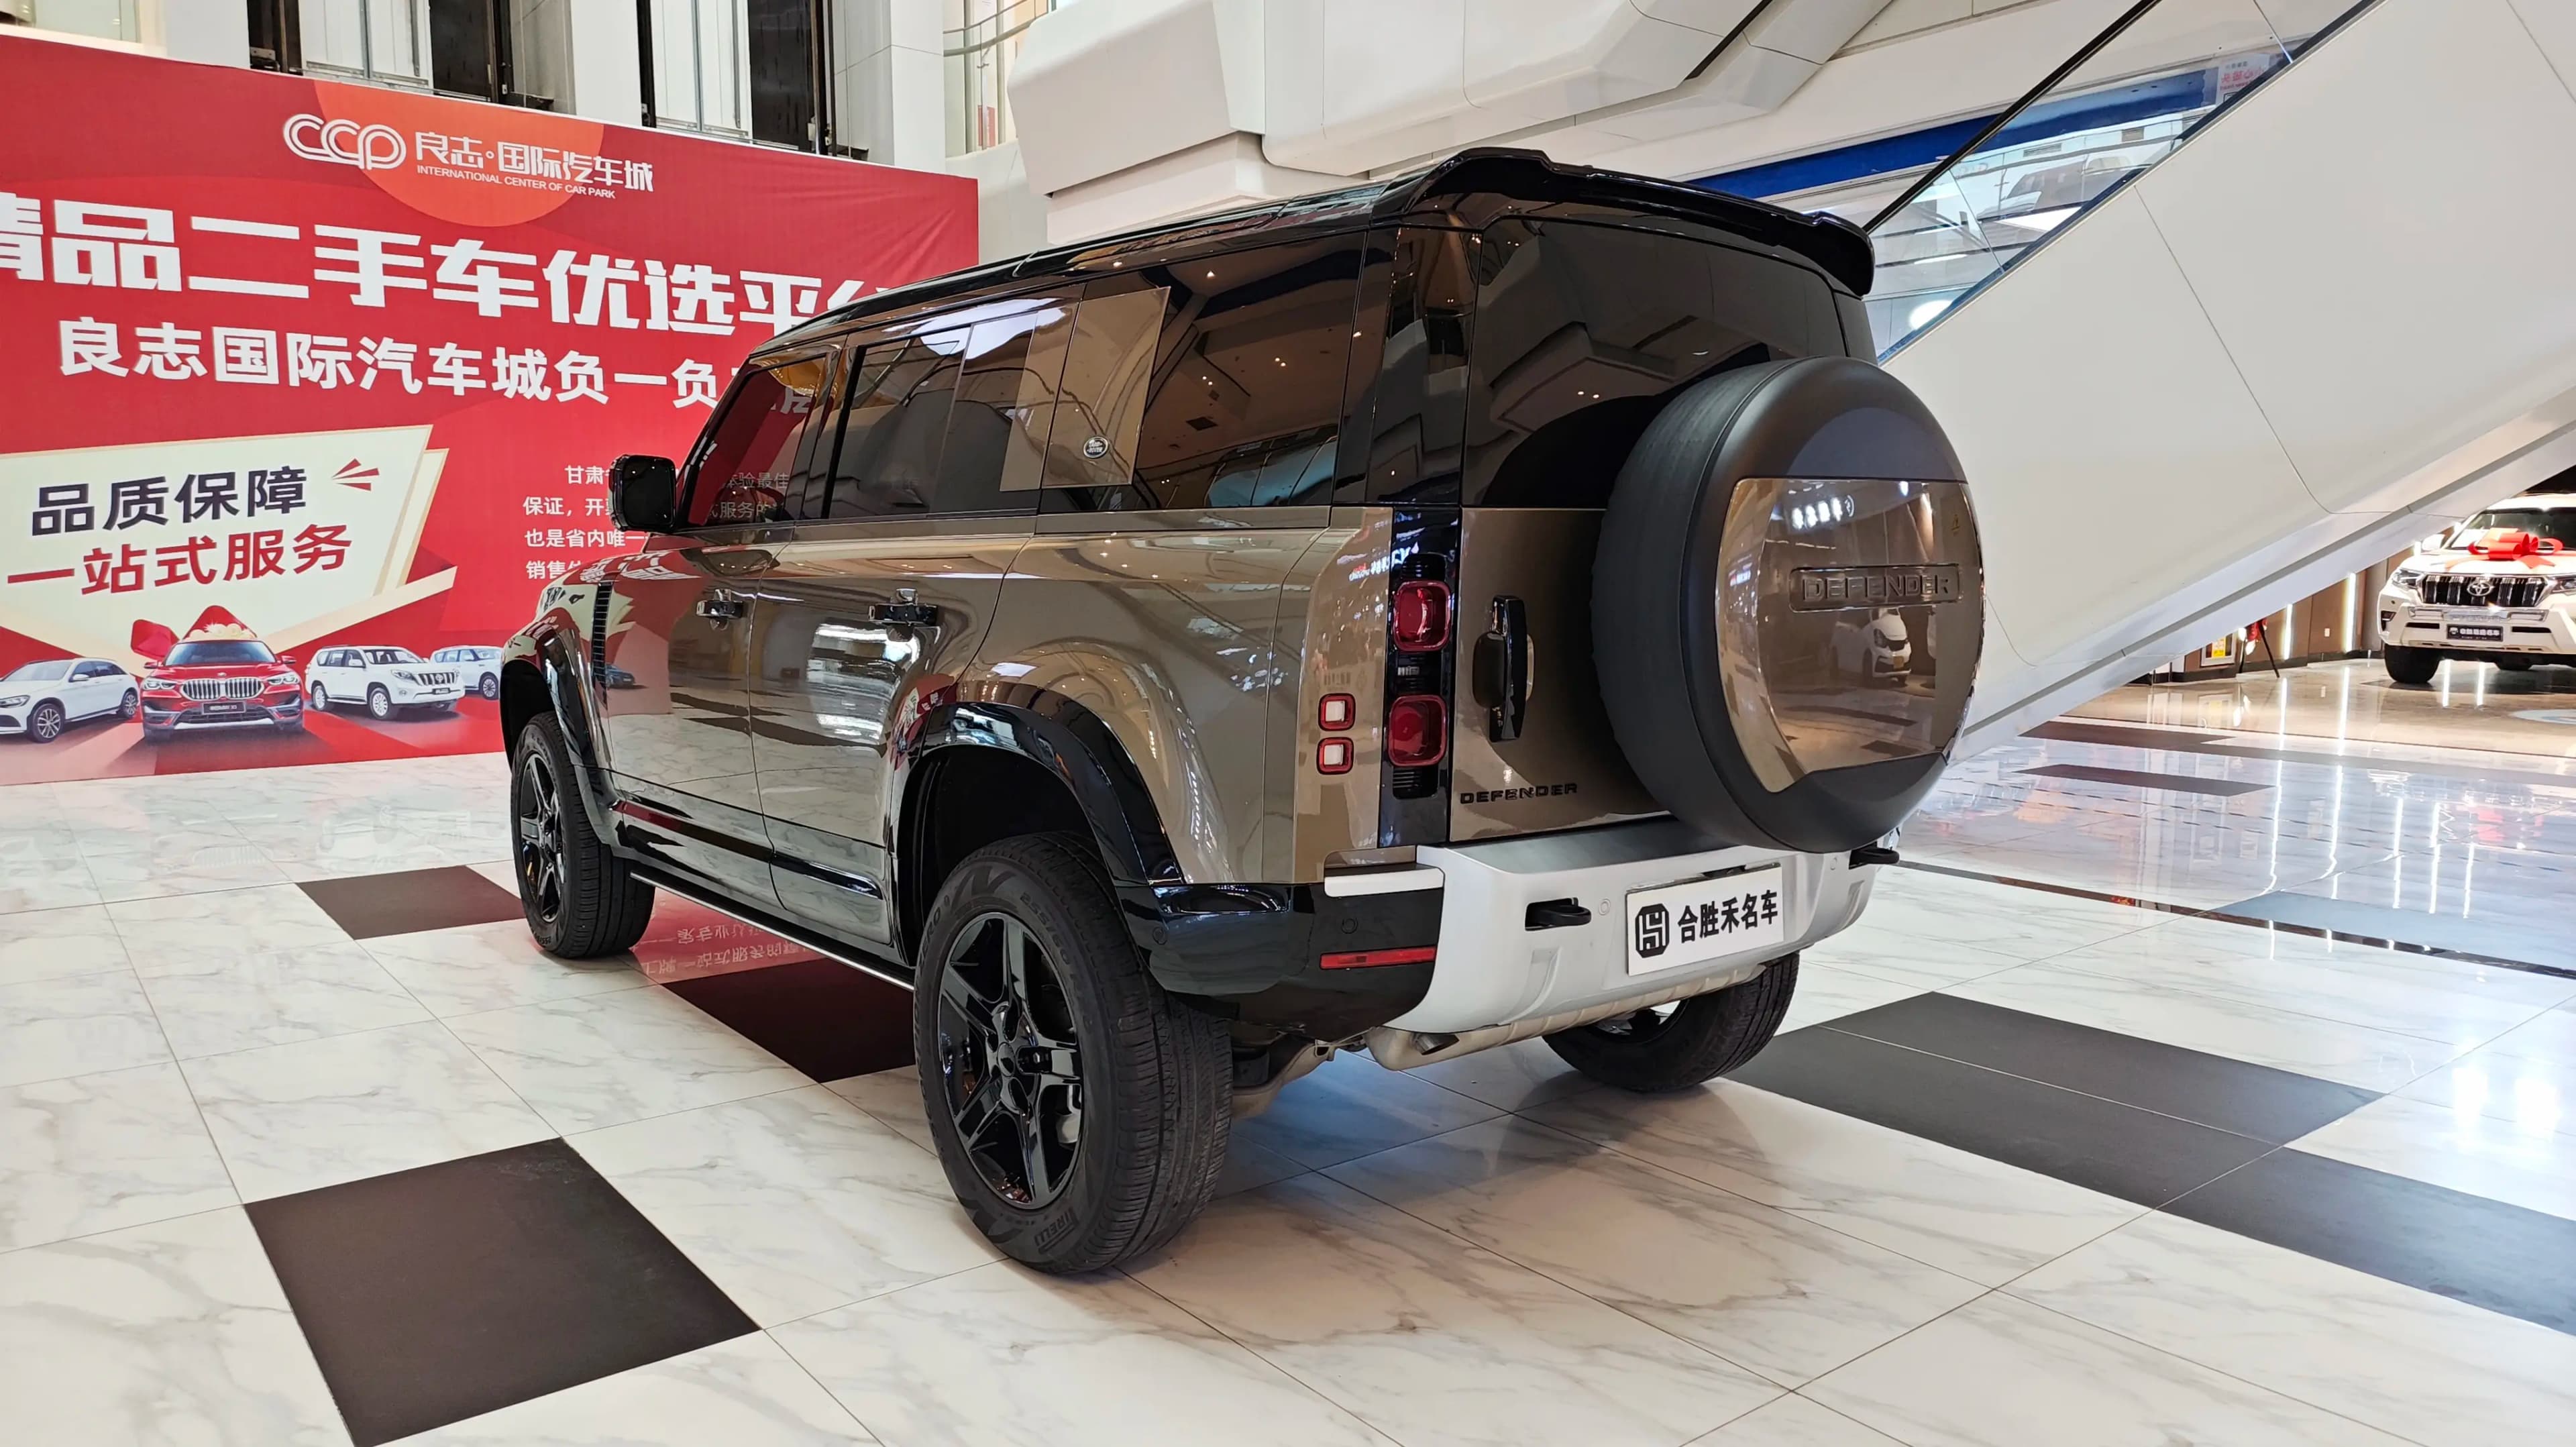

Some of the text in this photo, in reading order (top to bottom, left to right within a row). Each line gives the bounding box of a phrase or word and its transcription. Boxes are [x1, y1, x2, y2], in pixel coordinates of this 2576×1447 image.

[417, 165, 615, 199] INTERNATIONAL CENTER OF CAR PARK
[0, 192, 889, 335] 品二手车优选平
[59, 317, 810, 414] 良志国际汽车城负一负
[565, 466, 610, 484] 甘肃
[32, 466, 307, 536] 品质保障
[7, 523, 352, 596] 一站式服务
[525, 529, 649, 547] 也是省内唯一
[1804, 574, 1949, 601] DEFENDER
[1460, 783, 1578, 804] DEFENDER
[1678, 890, 1778, 943] 合胜禾名车
